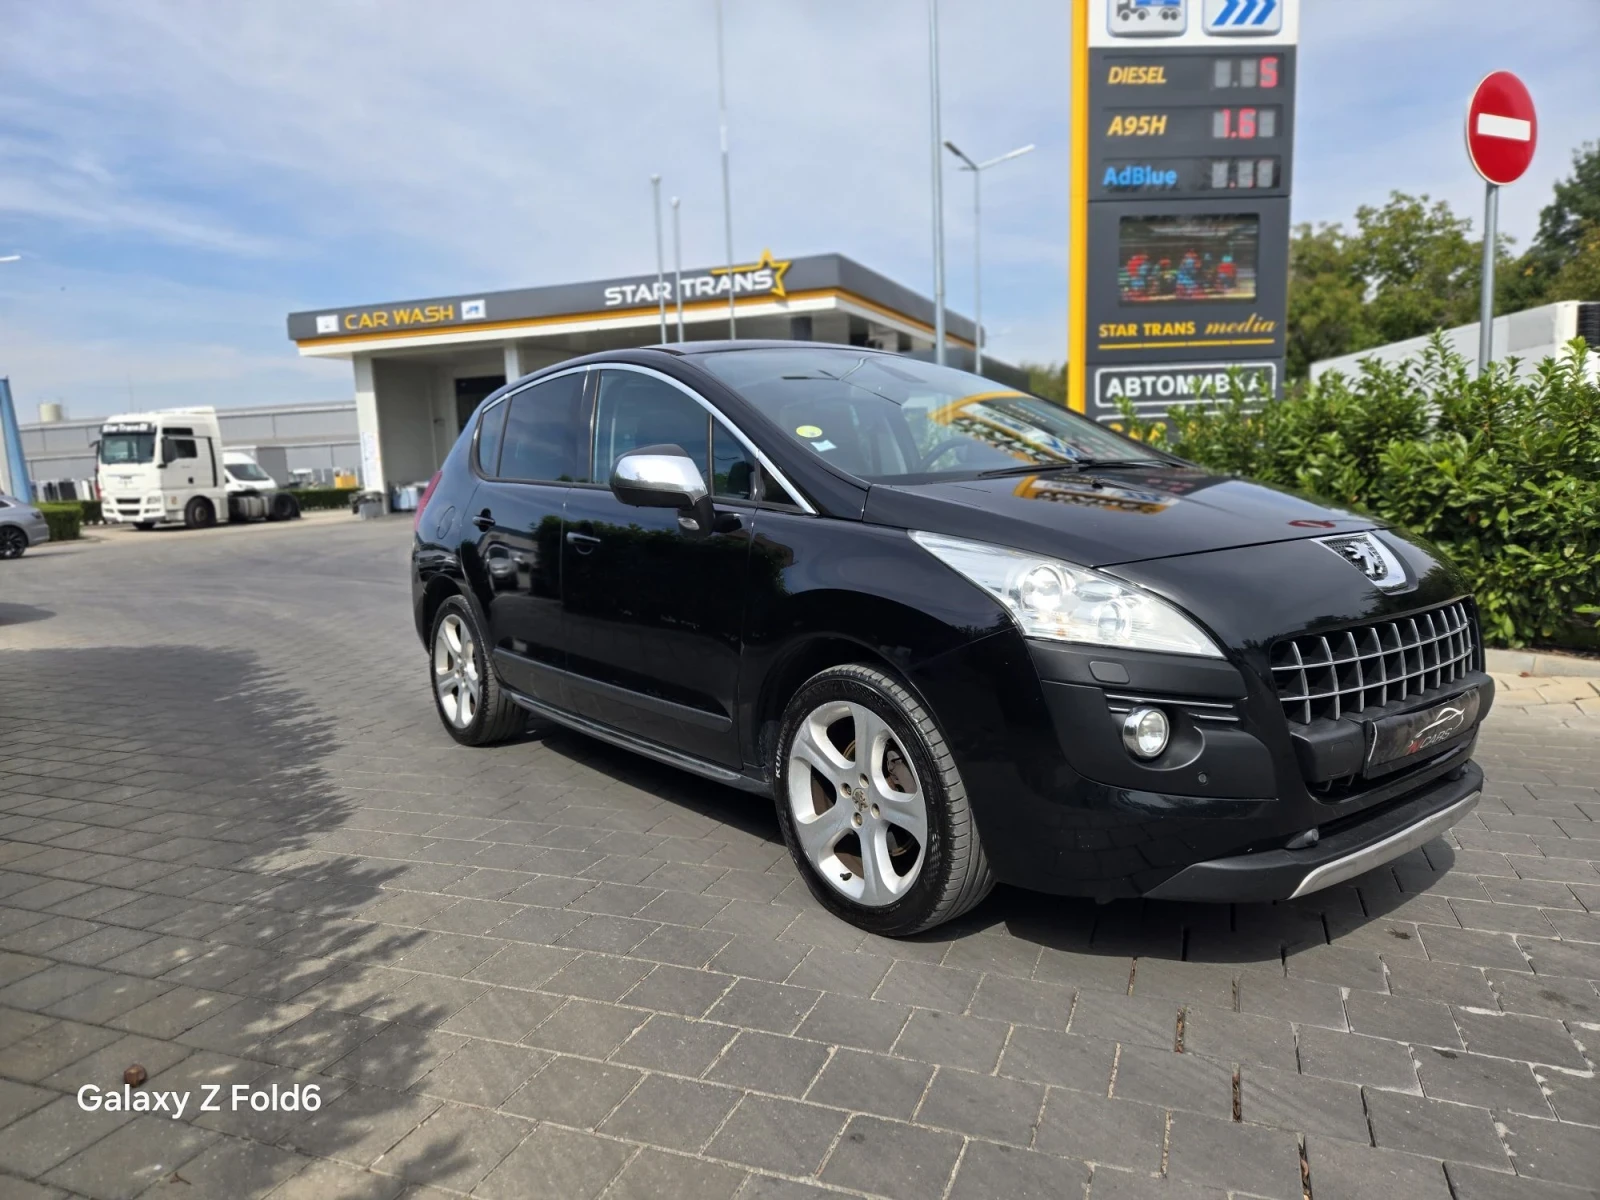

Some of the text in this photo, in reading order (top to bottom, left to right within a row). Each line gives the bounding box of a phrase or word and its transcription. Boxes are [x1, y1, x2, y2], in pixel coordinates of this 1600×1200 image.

[1107, 66, 1167, 84] DIESEL
[1107, 115, 1168, 136] A95H
[1103, 164, 1178, 186] AdBlue
[604, 269, 774, 305] STAR TRANS
[344, 305, 454, 330] CAR WASH
[1099, 313, 1275, 338] STAR TRANS media
